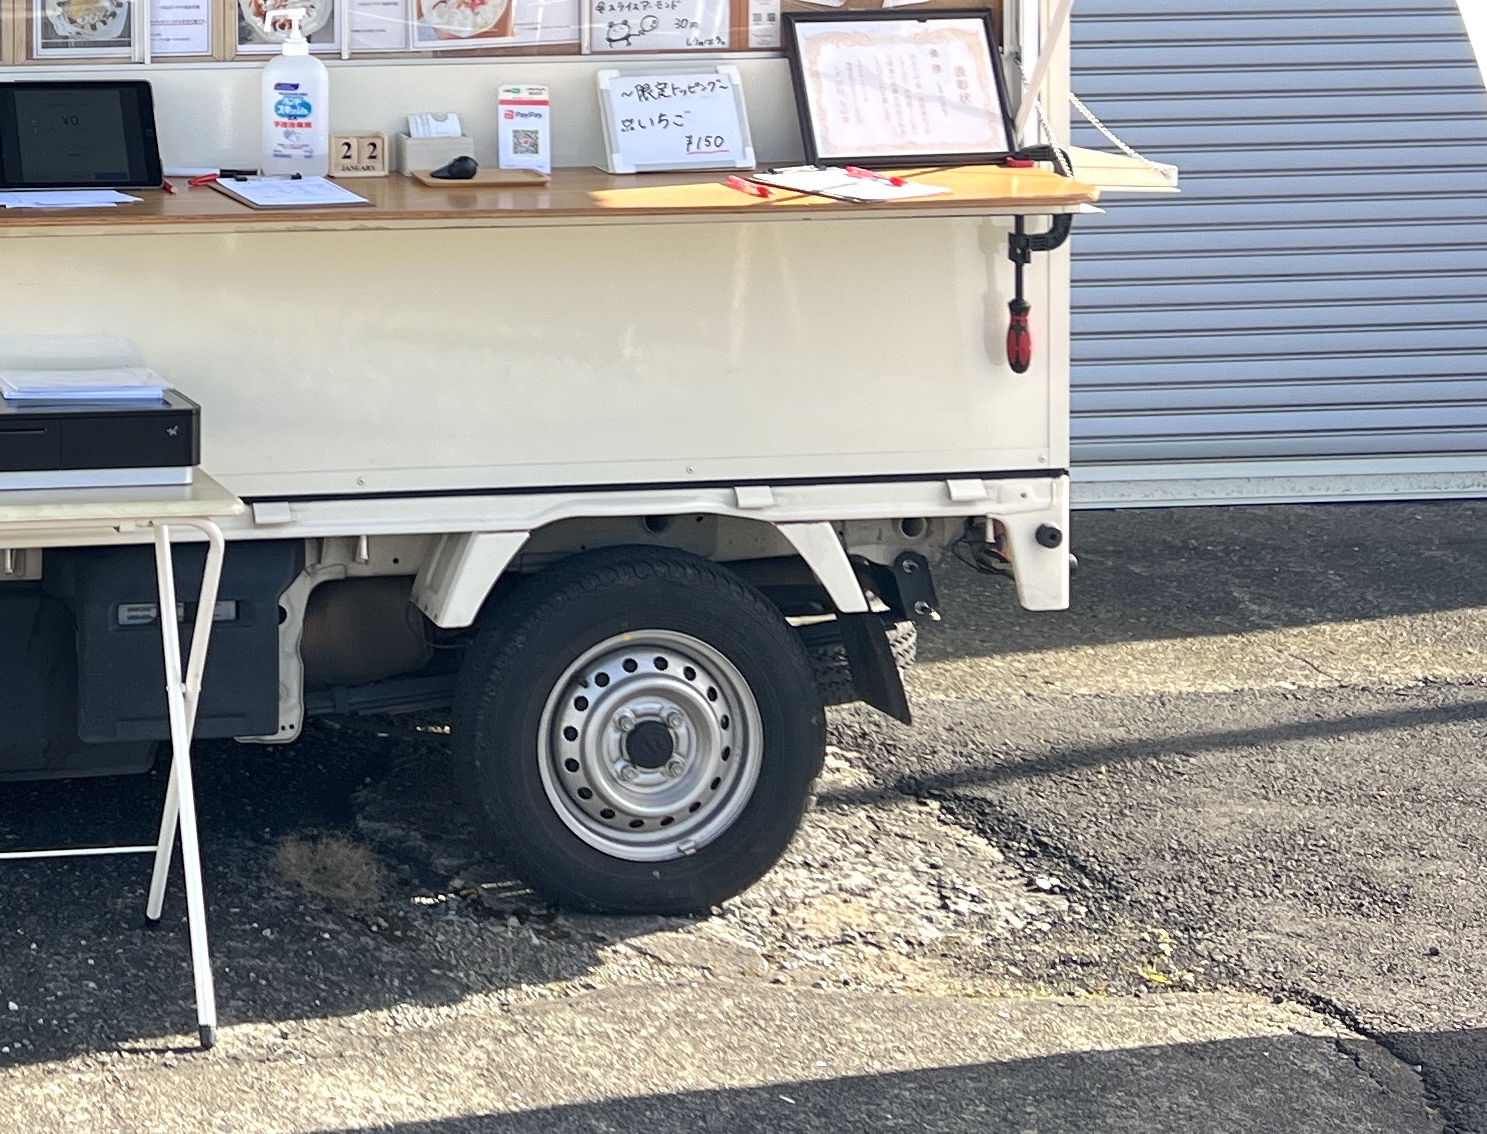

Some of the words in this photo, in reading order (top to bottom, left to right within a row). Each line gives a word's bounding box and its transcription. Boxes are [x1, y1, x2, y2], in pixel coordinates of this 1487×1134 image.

[515, 111, 543, 119] PayPay
[638, 110, 691, 130] いちご
[341, 164, 376, 172] JANUARY
